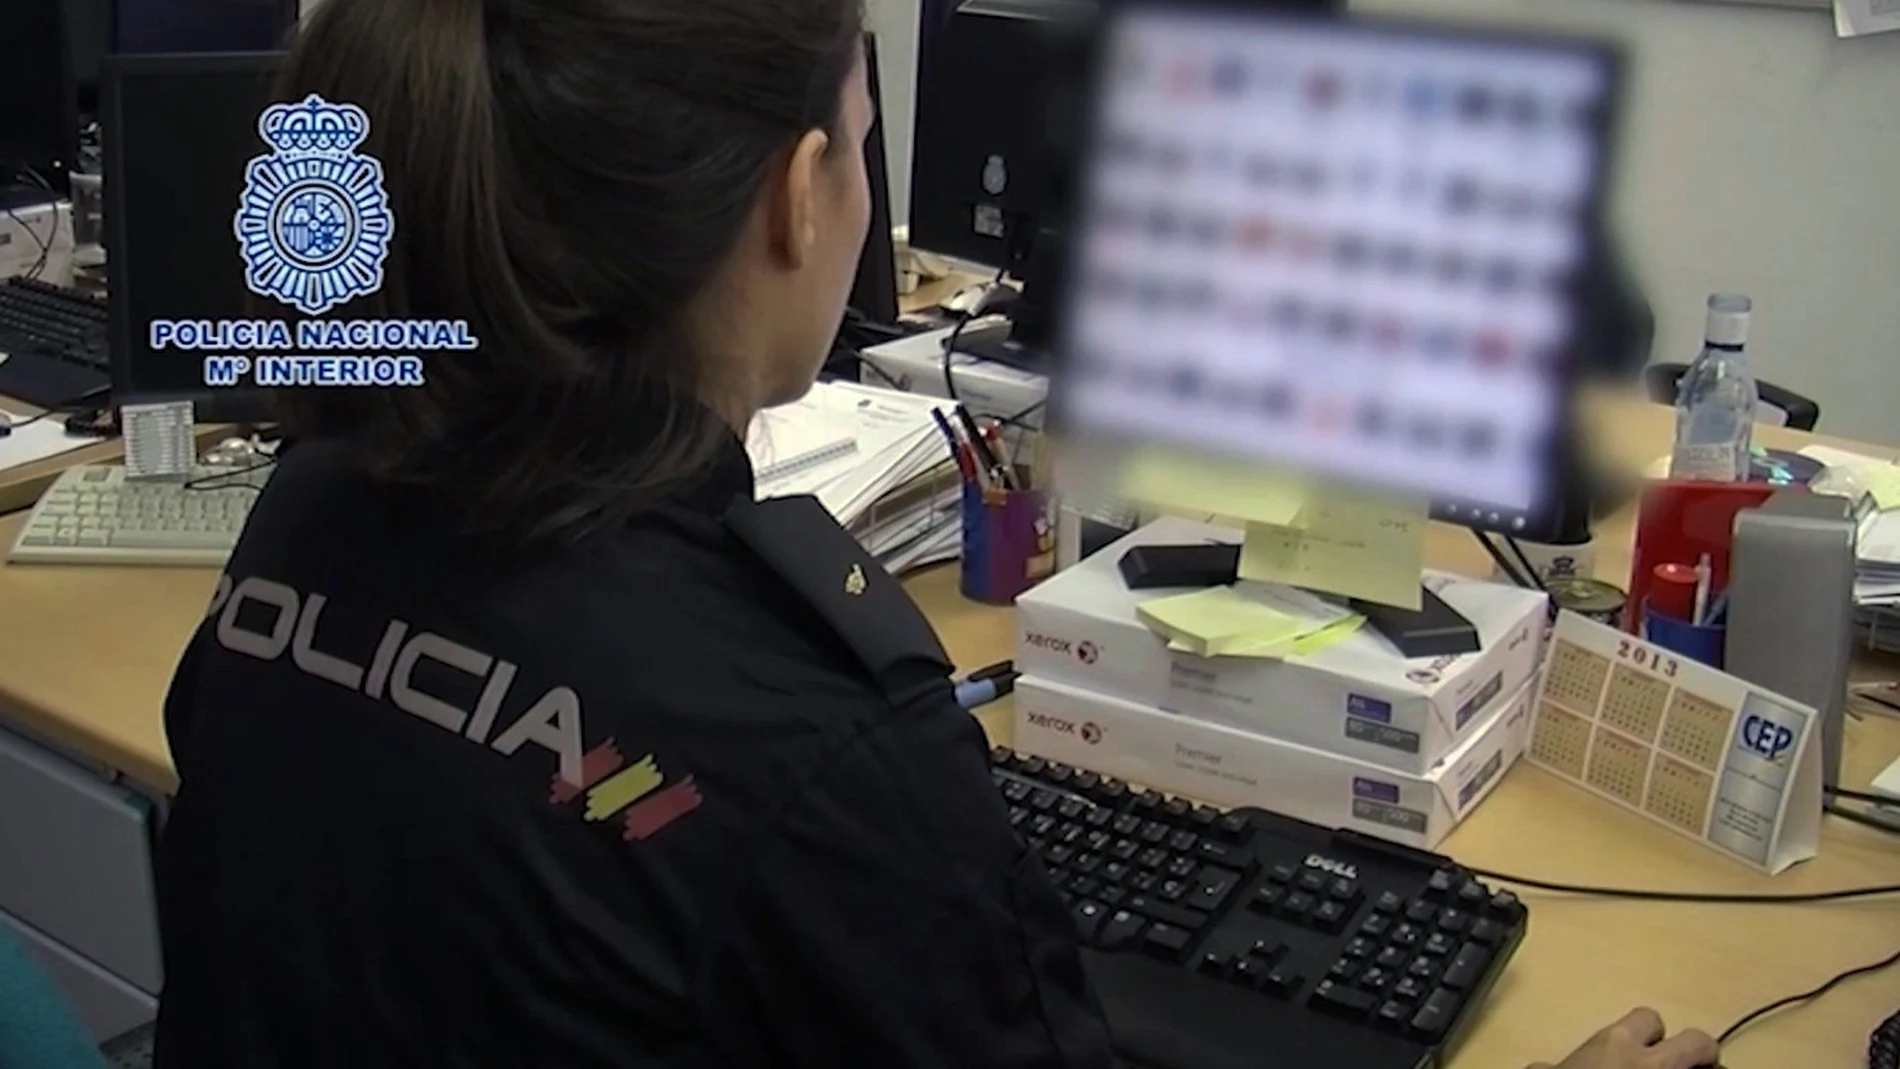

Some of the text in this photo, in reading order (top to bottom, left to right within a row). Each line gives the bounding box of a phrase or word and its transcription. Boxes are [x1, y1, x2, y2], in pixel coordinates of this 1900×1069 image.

[1025, 630, 1072, 655] xerox
[1616, 640, 1679, 678] 2013
[1027, 710, 1076, 736] xerox
[1742, 714, 1794, 760] CEP
[1304, 854, 1358, 879] DELL
